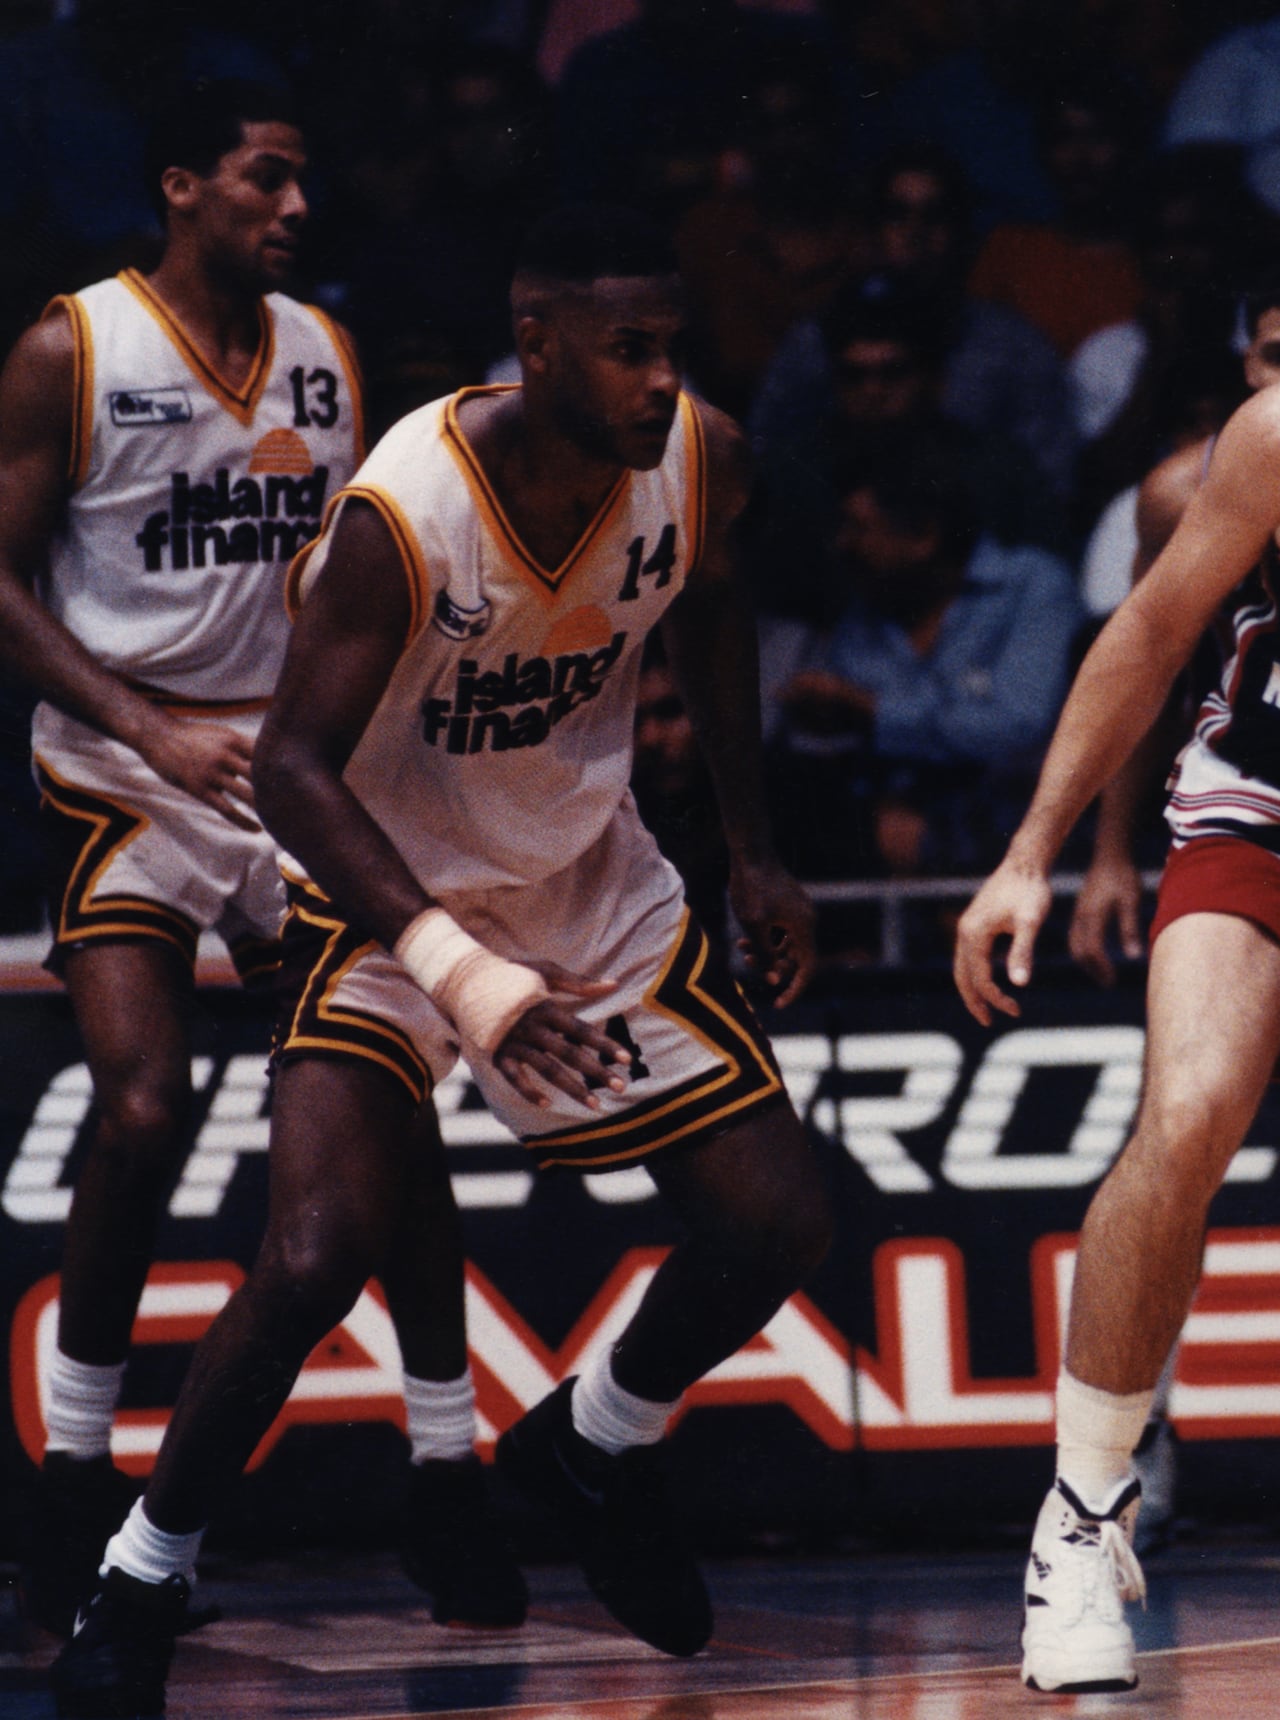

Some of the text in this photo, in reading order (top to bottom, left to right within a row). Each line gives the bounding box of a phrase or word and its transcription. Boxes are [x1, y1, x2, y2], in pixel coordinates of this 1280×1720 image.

[290, 366, 339, 428] 13
[171, 465, 329, 524] island
[136, 517, 322, 571] finan
[618, 524, 677, 601] 14
[454, 631, 628, 715] island
